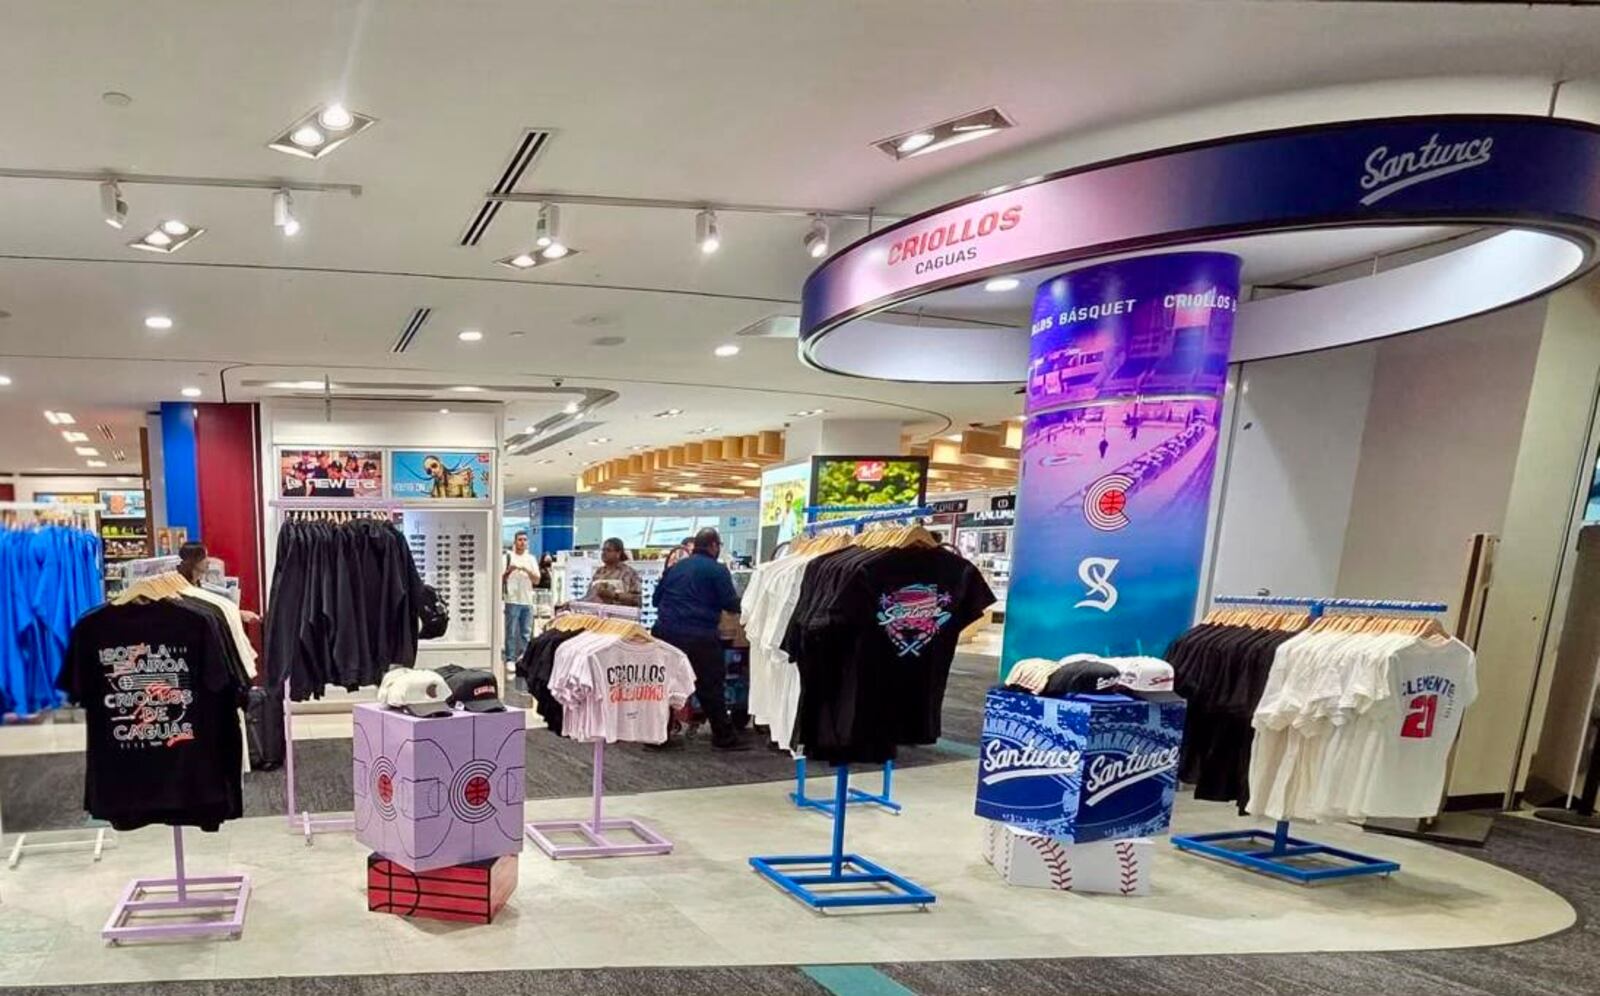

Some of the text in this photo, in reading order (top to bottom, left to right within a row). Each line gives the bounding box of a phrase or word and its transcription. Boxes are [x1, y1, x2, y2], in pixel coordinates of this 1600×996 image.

[1360, 133, 1493, 200] Santurce
[887, 205, 1023, 266] CRIOLLOS
[915, 247, 978, 275] CAGUAS
[1059, 299, 1136, 326] BÁSQUET
[1163, 293, 1231, 309] CRIOLLOS
[104, 689, 193, 708] CRIOLLOS
[1400, 694, 1439, 738] 21
[113, 722, 194, 741] CAGUAS
[982, 738, 1081, 780] Santurce
[1086, 746, 1180, 800] Santurce
